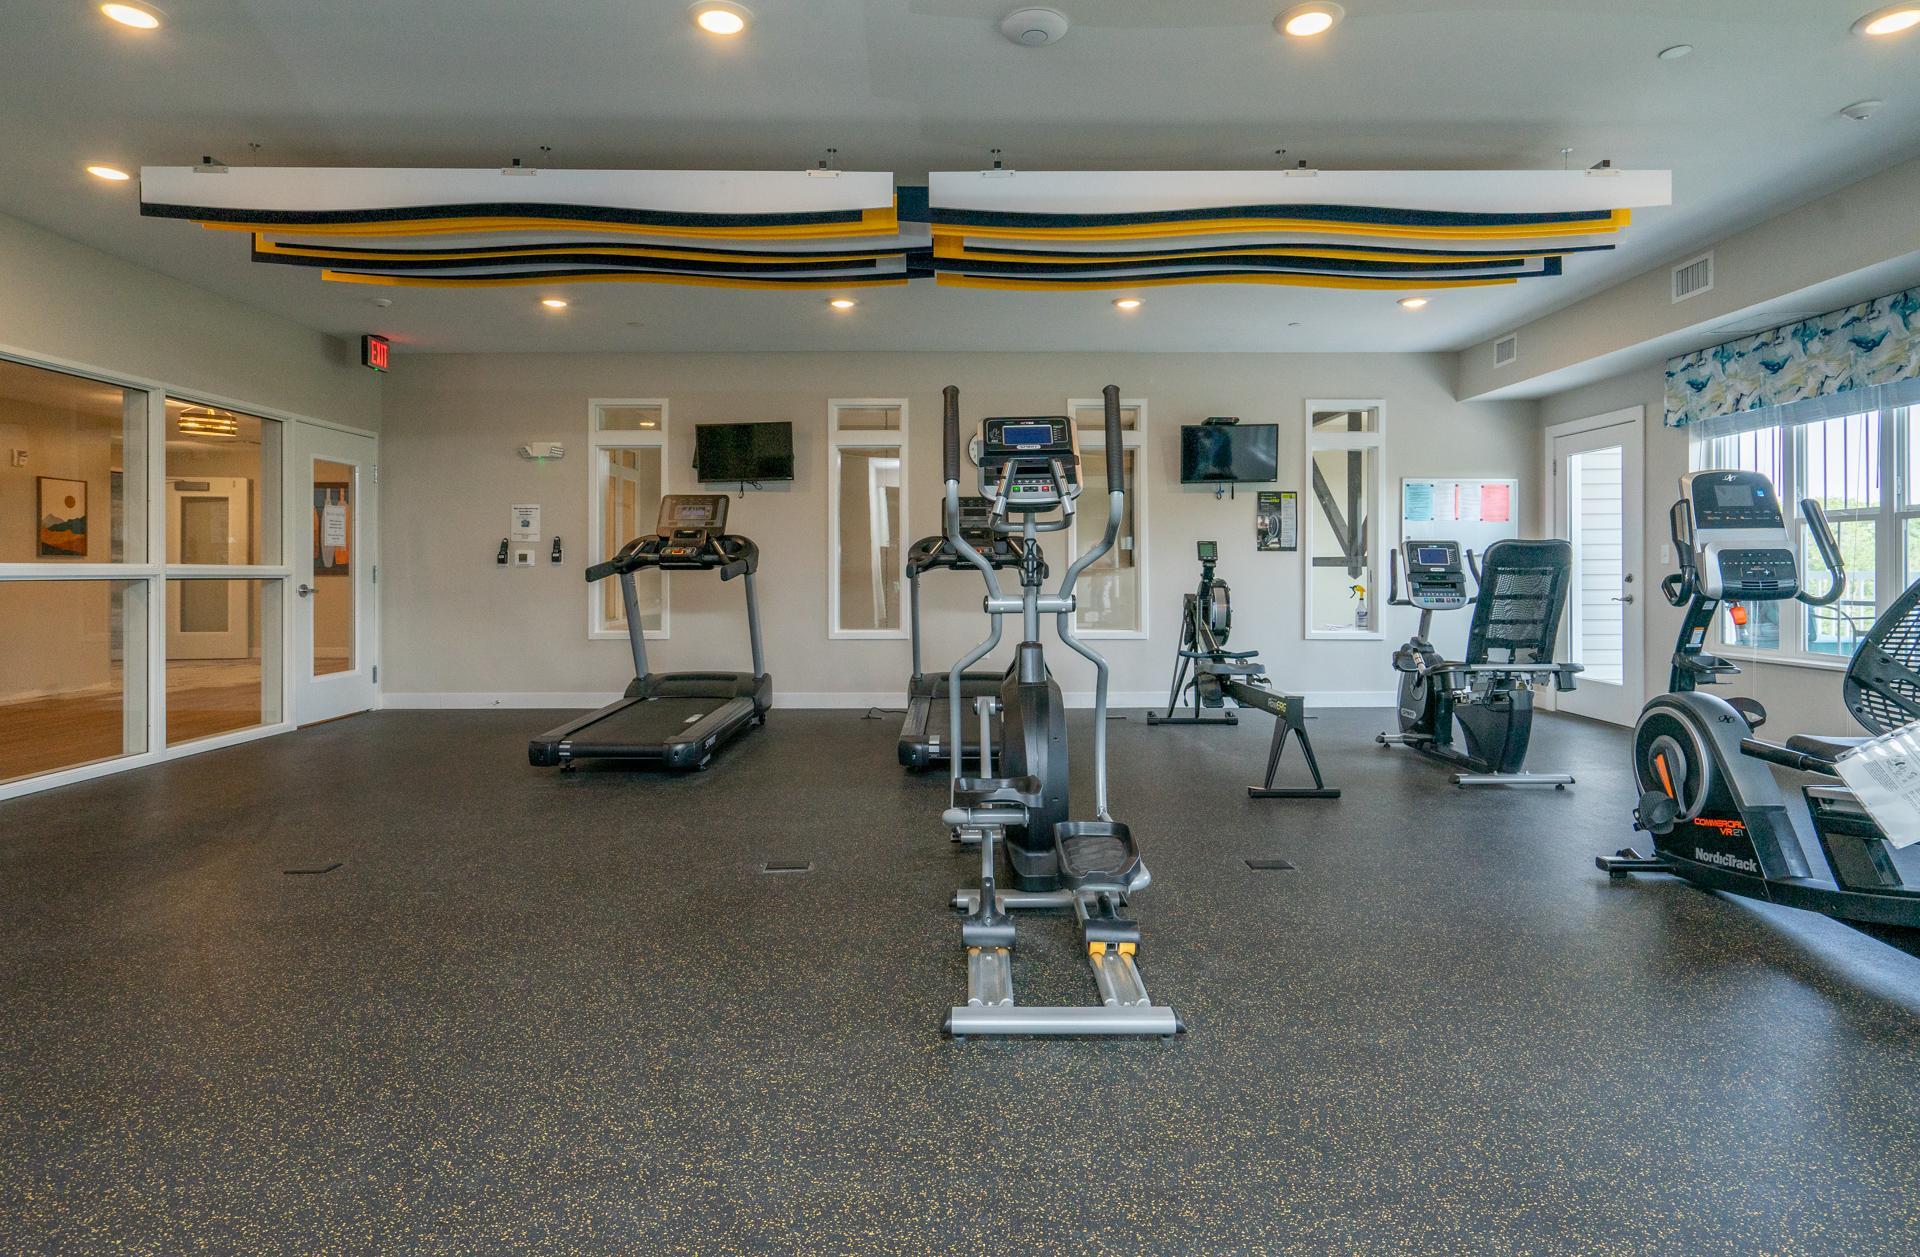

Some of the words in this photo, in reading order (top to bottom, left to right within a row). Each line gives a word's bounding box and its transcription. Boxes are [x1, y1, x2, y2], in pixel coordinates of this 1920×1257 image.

[372, 340, 387, 368] EXIT
[1694, 817, 1746, 829] COMMERCIAL
[1695, 847, 1757, 872] NordicTrack
